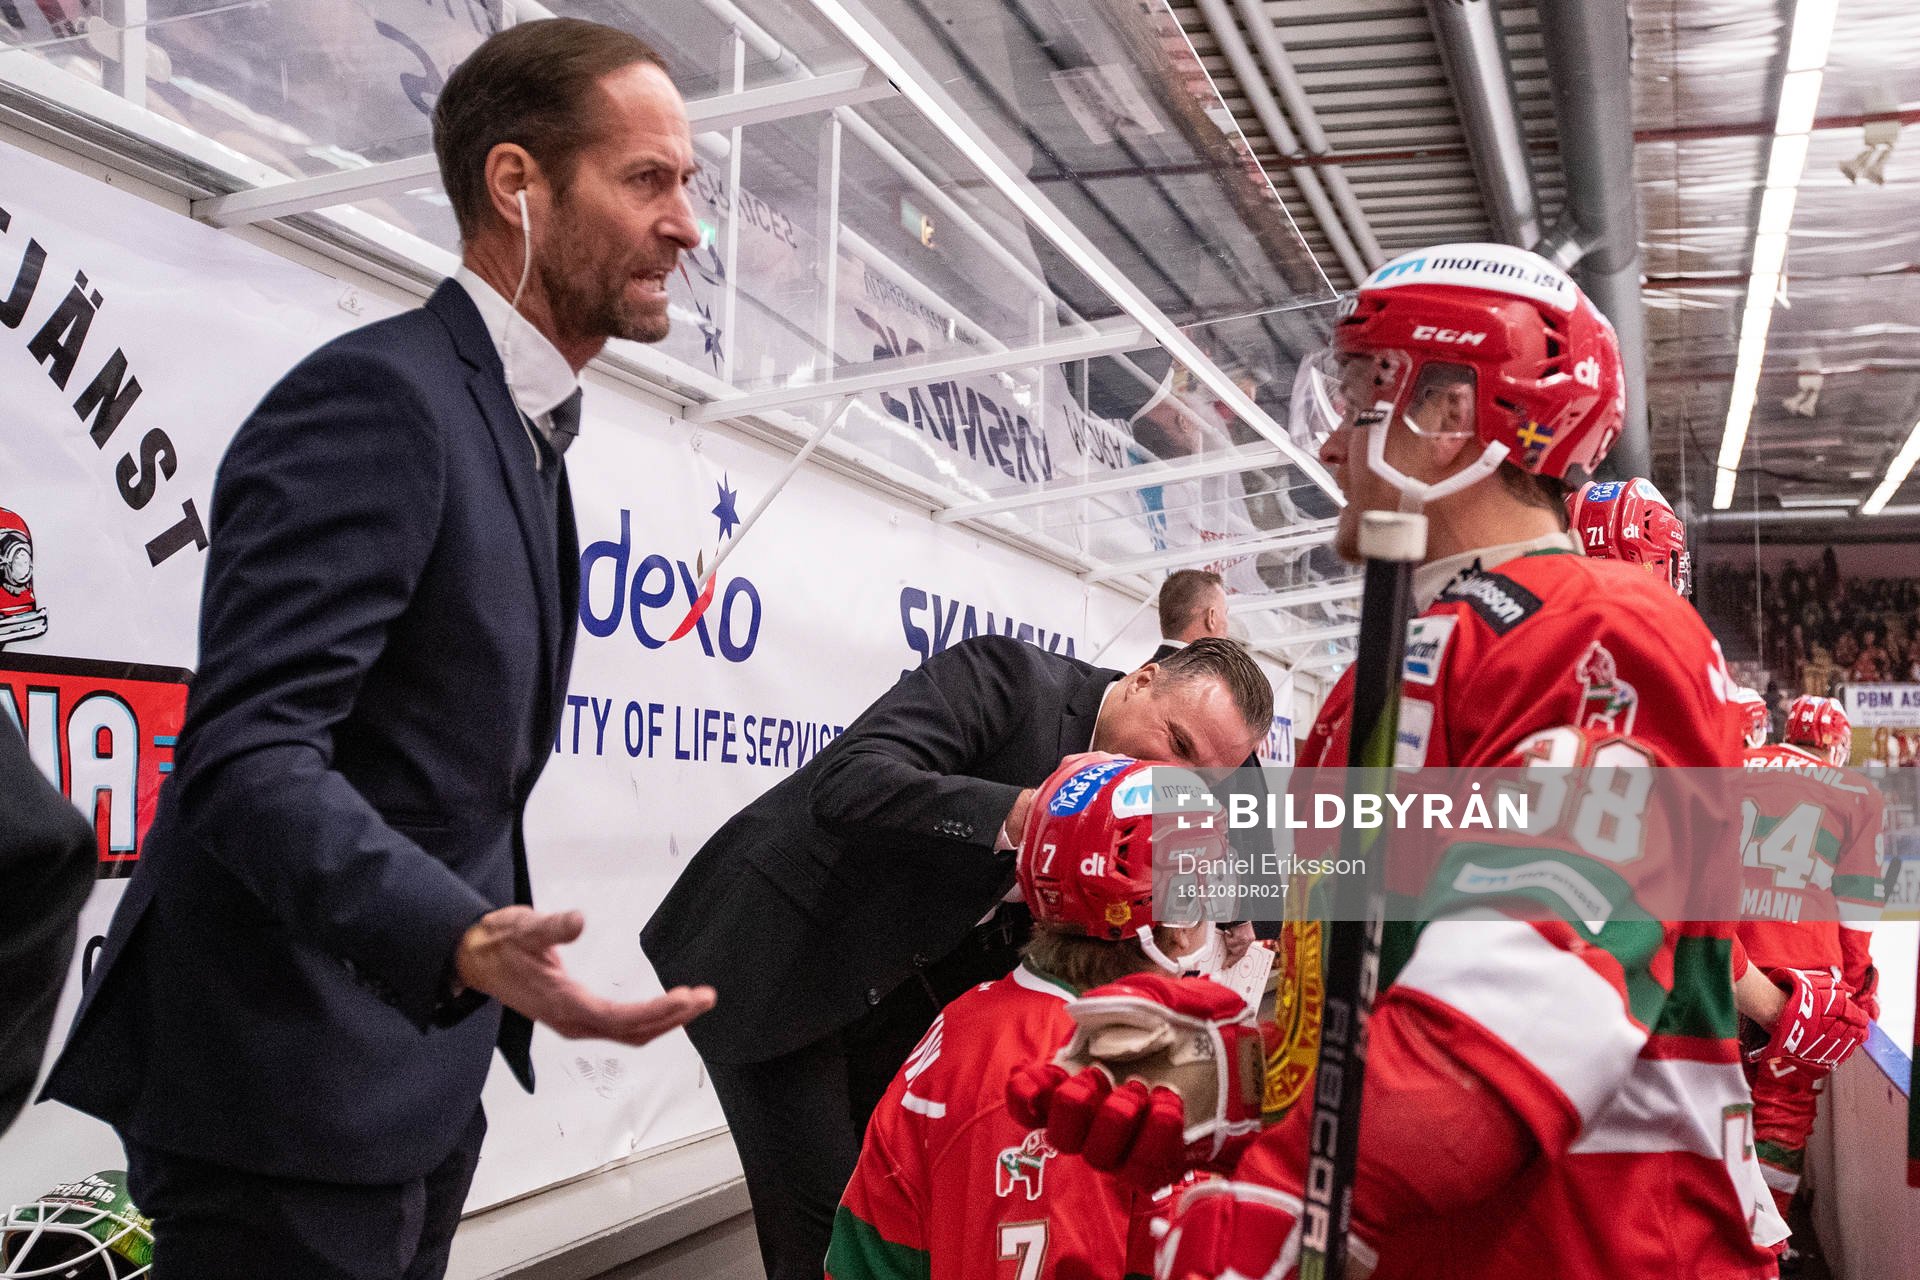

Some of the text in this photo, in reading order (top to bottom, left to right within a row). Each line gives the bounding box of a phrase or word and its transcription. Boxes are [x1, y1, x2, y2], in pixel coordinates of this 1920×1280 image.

[1412, 325, 1488, 347] CCM
[0, 207, 209, 567] JÄNST
[1587, 526, 1605, 547] 71
[1623, 523, 1640, 539] dt
[1857, 691, 1893, 708] PBM
[625, 701, 665, 758] OF
[675, 705, 738, 764] LIFE
[1494, 727, 1657, 865] 38
[1041, 844, 1057, 874] 7
[1080, 852, 1107, 877] dt
[998, 1219, 1050, 1280] 7
